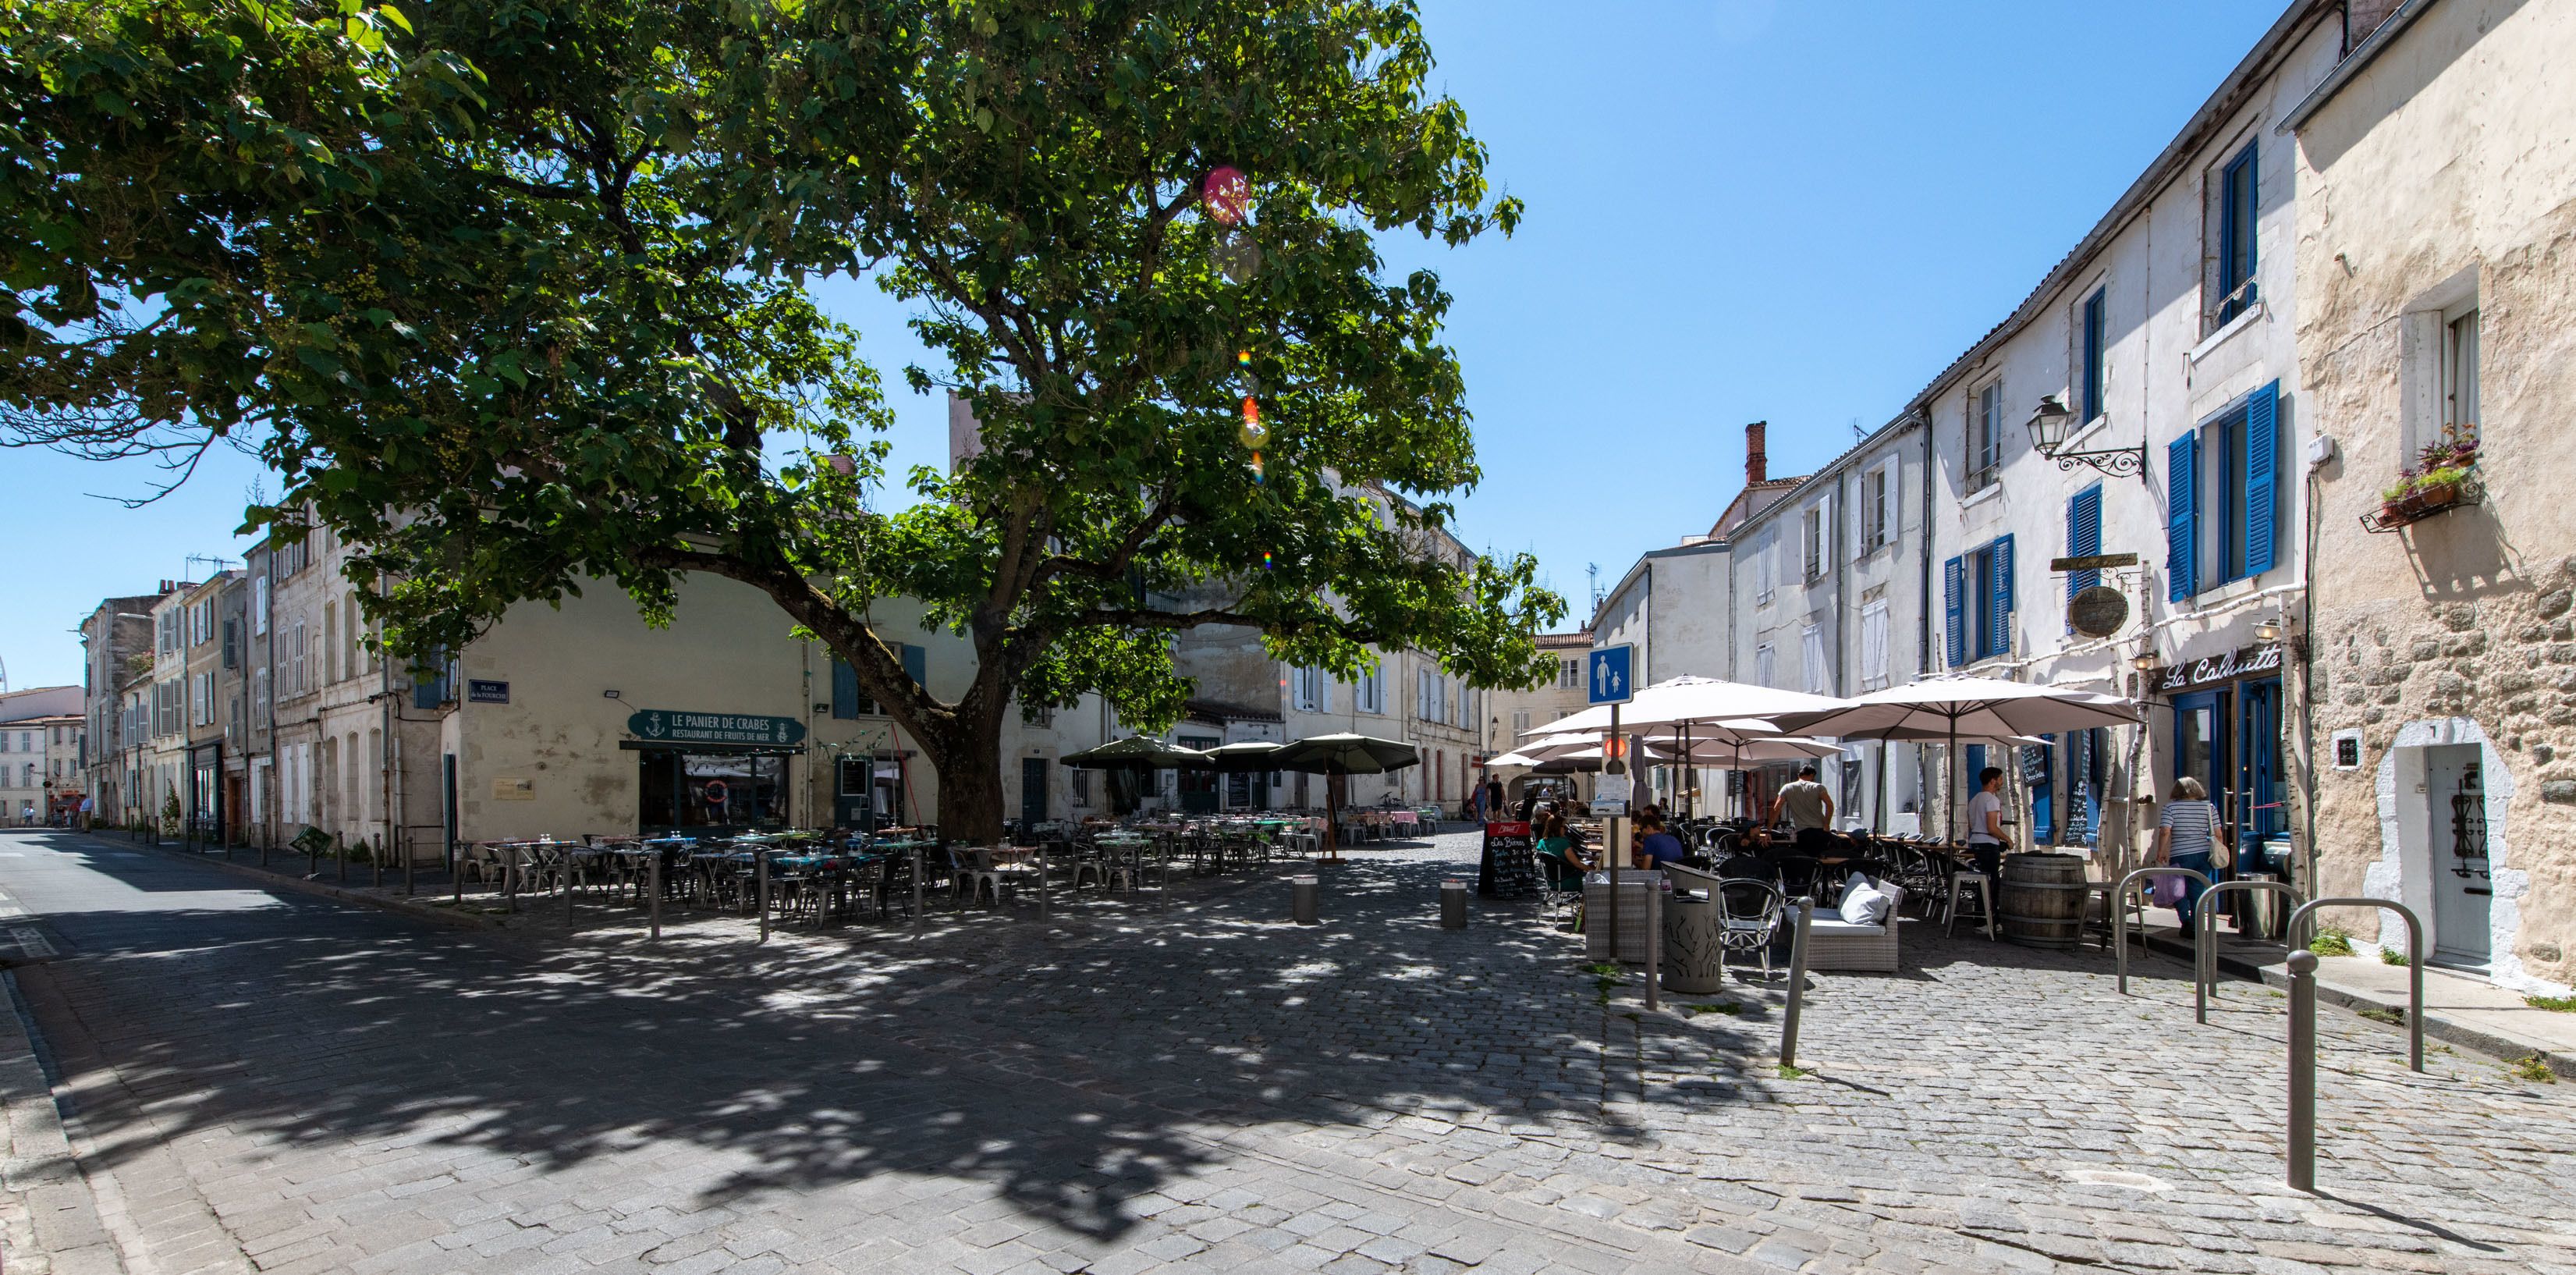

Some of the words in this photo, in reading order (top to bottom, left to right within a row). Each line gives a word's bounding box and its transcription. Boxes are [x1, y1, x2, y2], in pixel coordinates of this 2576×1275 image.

[2163, 658, 2187, 689] La
[2193, 644, 2282, 684] Calhutte
[672, 715, 683, 726] LE
[686, 716, 719, 728] PANIER
[722, 717, 734, 729] DE
[736, 718, 769, 730] CRABES
[672, 730, 712, 739] RESTAURANT
[714, 730, 722, 739] DE
[724, 731, 745, 740] FRUITS
[747, 732, 755, 740] DE
[757, 733, 769, 741] MER
